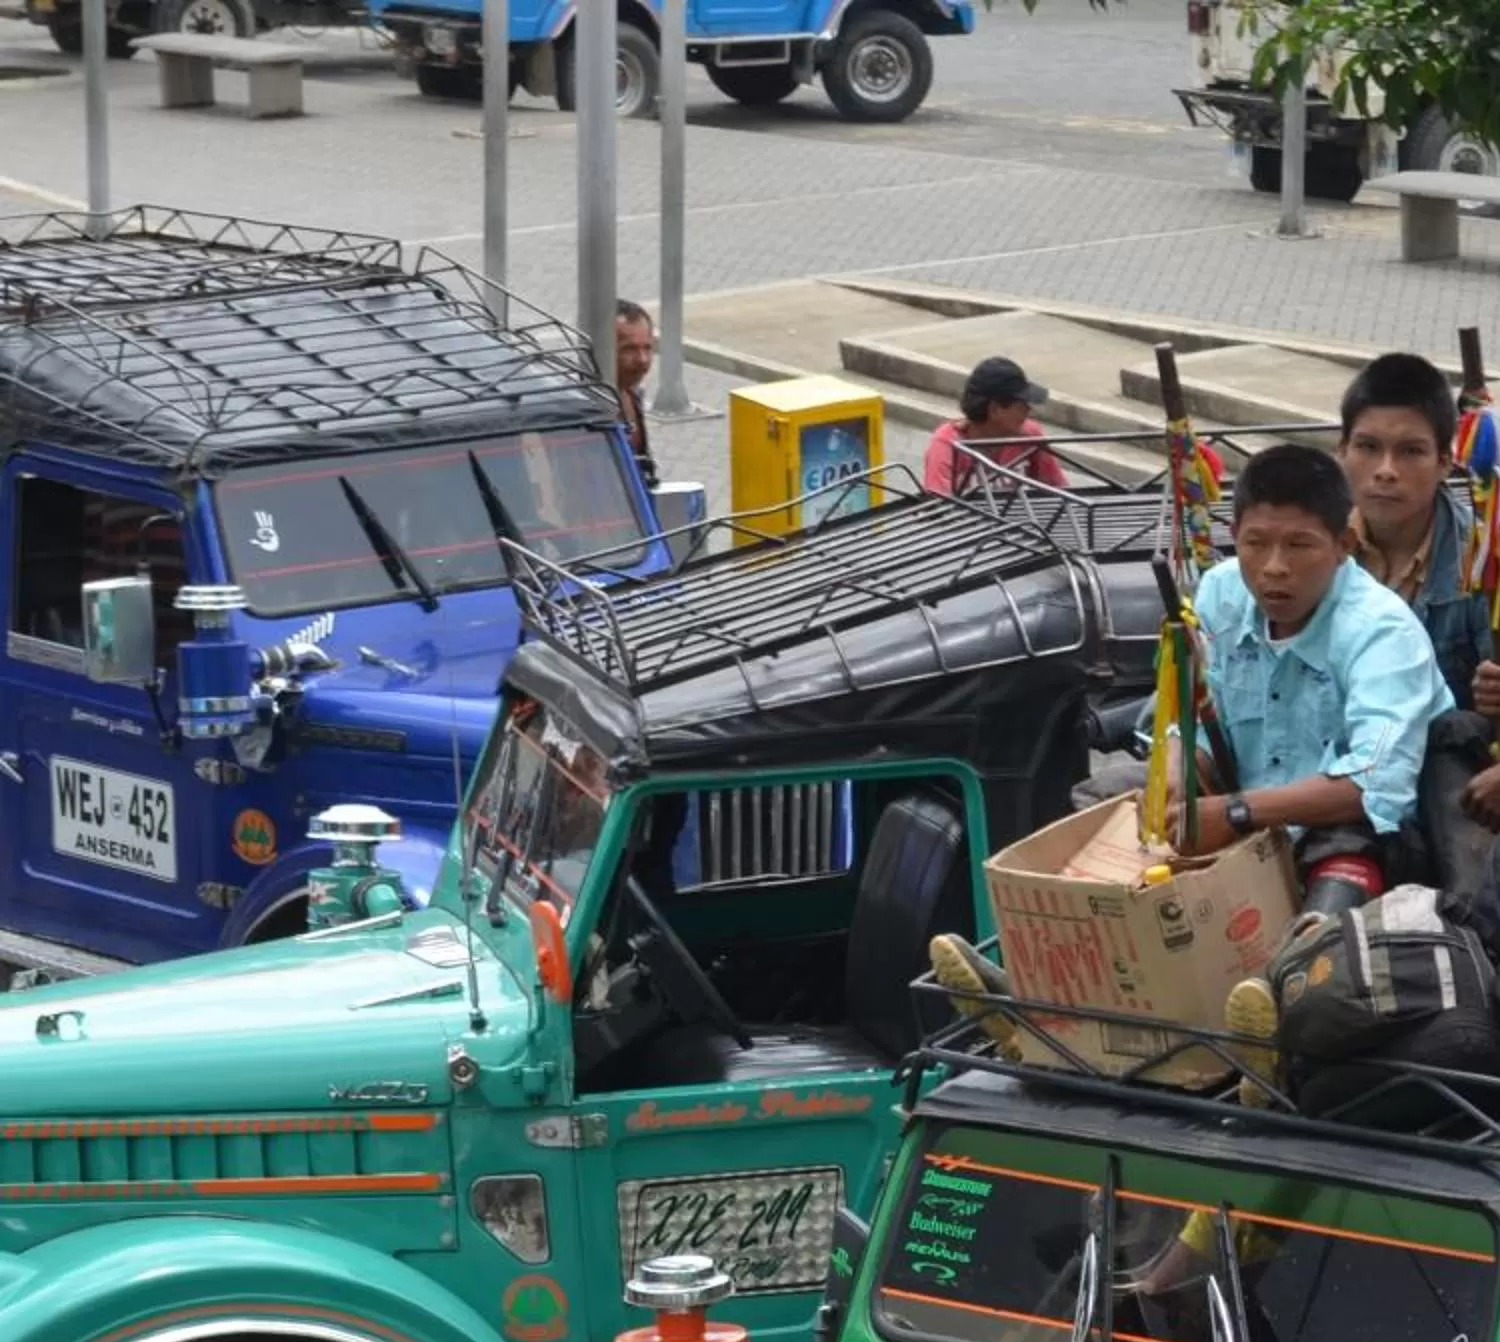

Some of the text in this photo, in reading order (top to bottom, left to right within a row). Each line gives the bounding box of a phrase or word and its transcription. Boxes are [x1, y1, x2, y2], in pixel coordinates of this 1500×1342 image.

[56, 765, 170, 844] WEJ 452
[75, 832, 156, 868] ANSERMA
